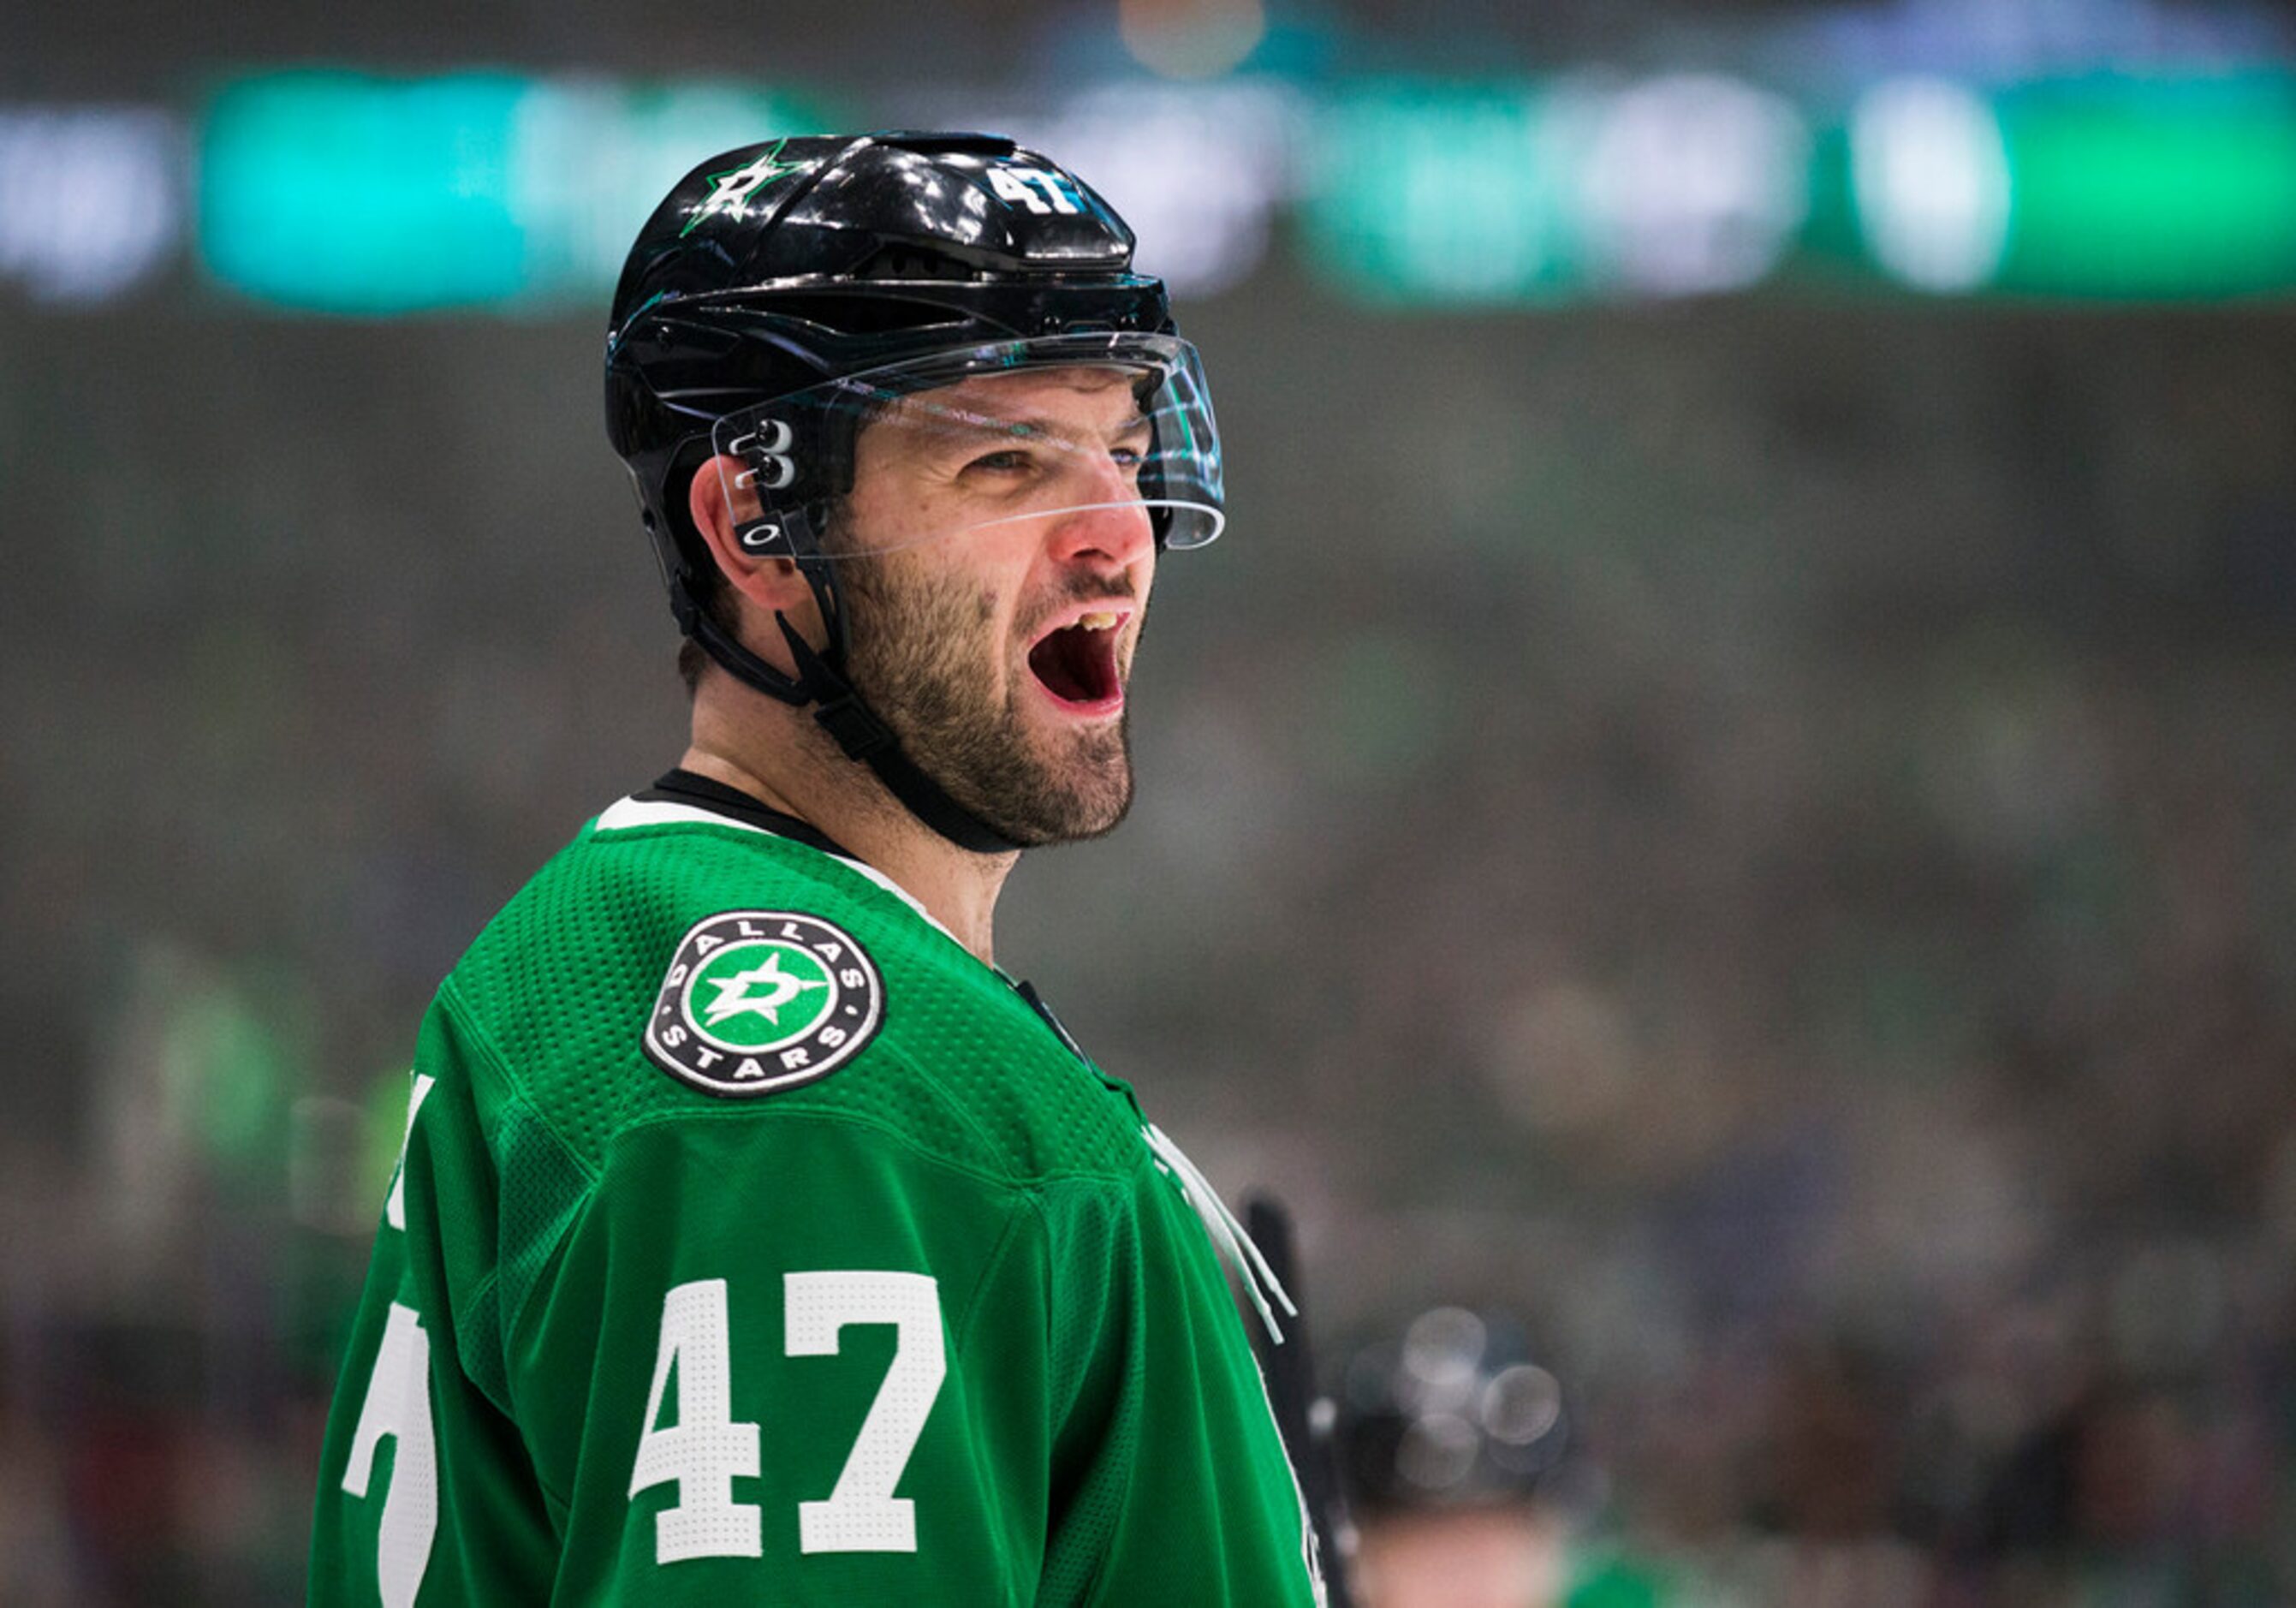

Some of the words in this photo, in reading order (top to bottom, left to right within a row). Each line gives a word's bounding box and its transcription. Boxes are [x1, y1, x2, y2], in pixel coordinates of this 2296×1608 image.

[985, 168, 1079, 214] 47
[665, 920, 865, 990] DALLAS
[662, 1024, 847, 1079] STARS
[628, 1270, 947, 1565] 47
